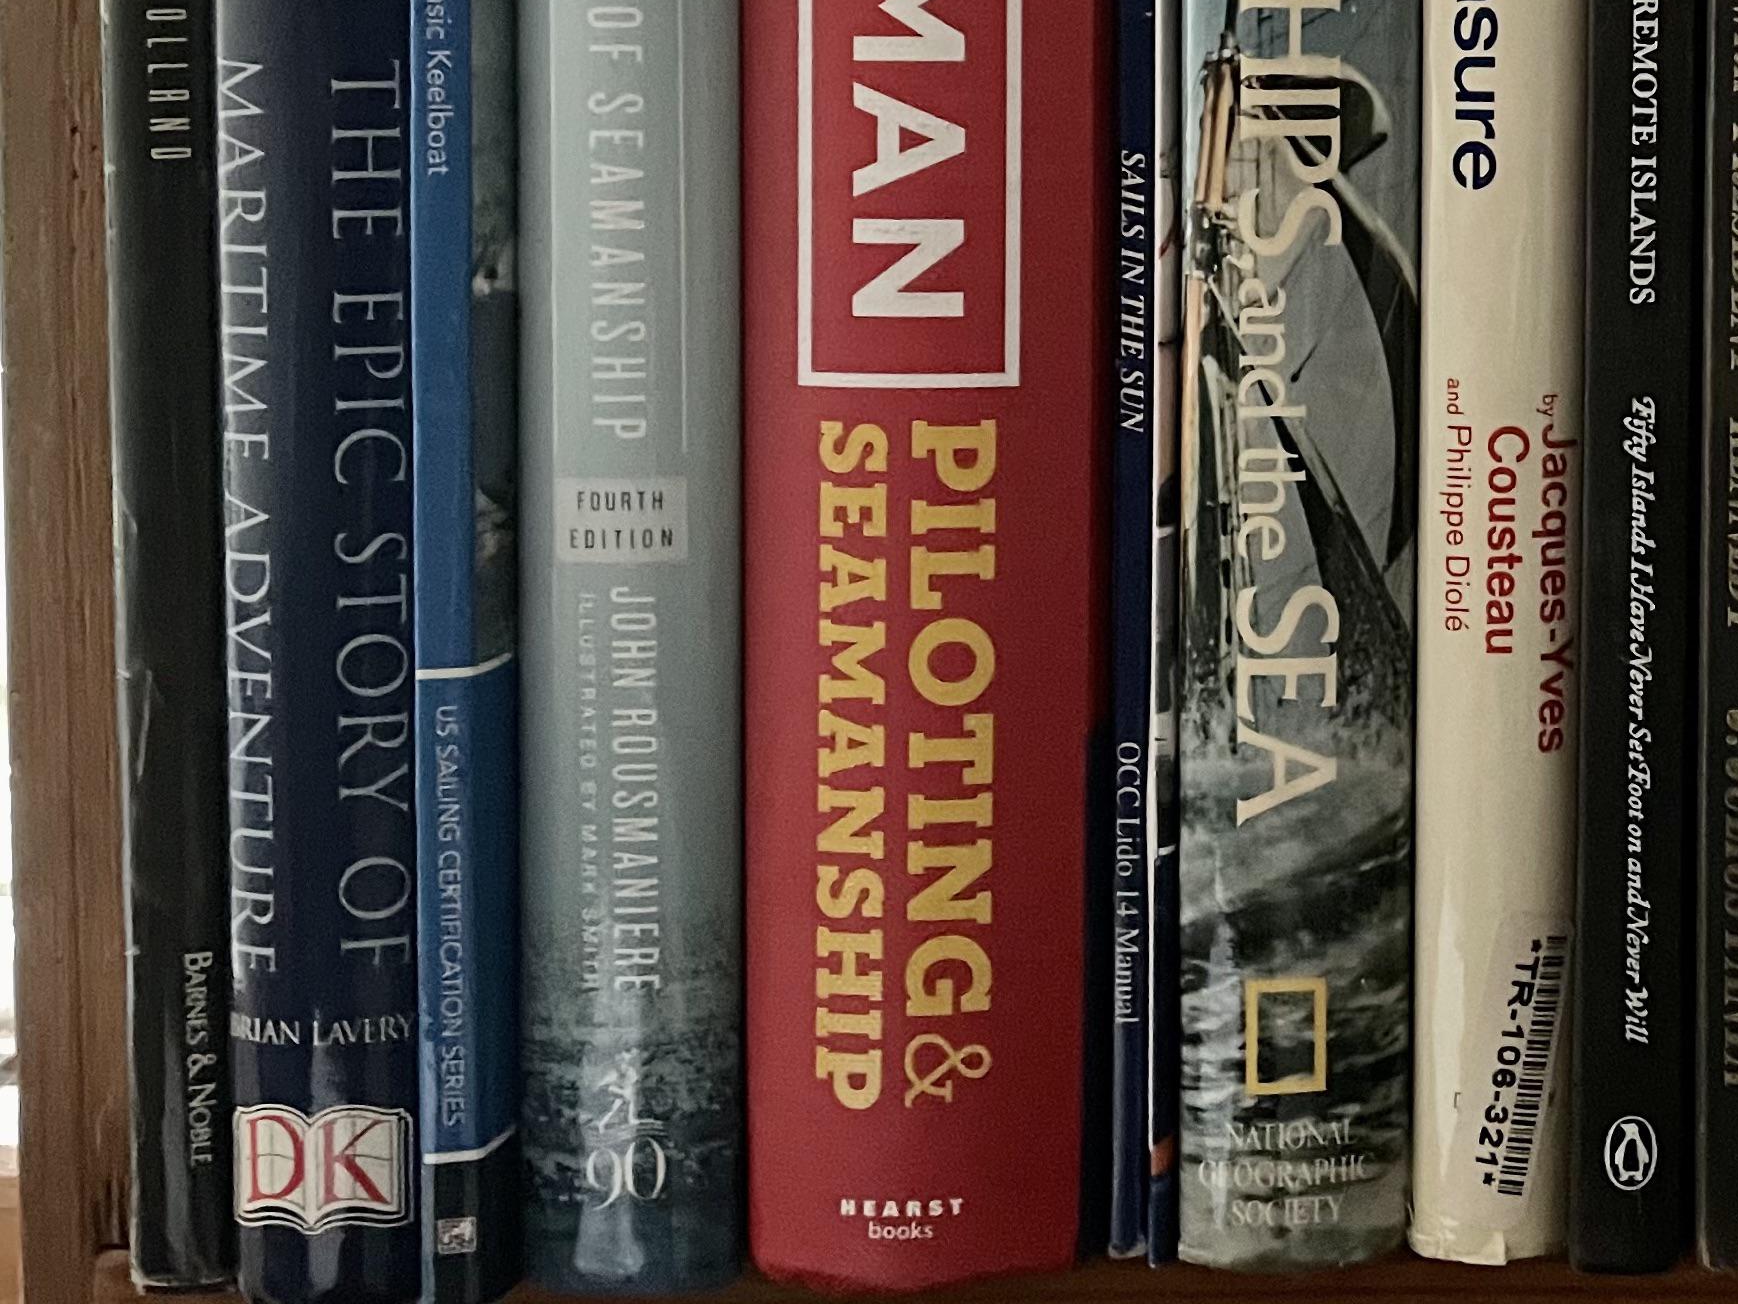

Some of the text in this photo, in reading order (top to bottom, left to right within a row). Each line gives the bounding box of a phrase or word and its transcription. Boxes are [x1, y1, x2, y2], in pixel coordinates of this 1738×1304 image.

[586, 5, 643, 63] OF
[587, 91, 647, 441] SEAMANSHIP
[1119, 149, 1146, 433] SAILS IN THE SUN
[1238, 282, 1307, 417] and
[1628, 157, 1657, 305] ISLANDS
[217, 58, 277, 974] MARITIME ADVENTURE
[331, 58, 412, 967] THE EPIC STORY OF
[569, 528, 674, 549] EDITION
[576, 490, 664, 511] FOURTH
[1237, 453, 1307, 562] the
[1439, 377, 1472, 633] and Philippe Diolé
[1485, 424, 1530, 654] Cousteau
[1531, 393, 1579, 754] by Jacques-Yves
[609, 586, 661, 994] JOHN ROUSMANIERE
[815, 419, 889, 1110] SEAMANSHIP
[904, 418, 997, 1108] PILOTING &
[1236, 584, 1340, 829] SEA
[247, 1114, 390, 1205] DK
[840, 1197, 964, 1217] HEARST
[867, 1221, 934, 1241] books
